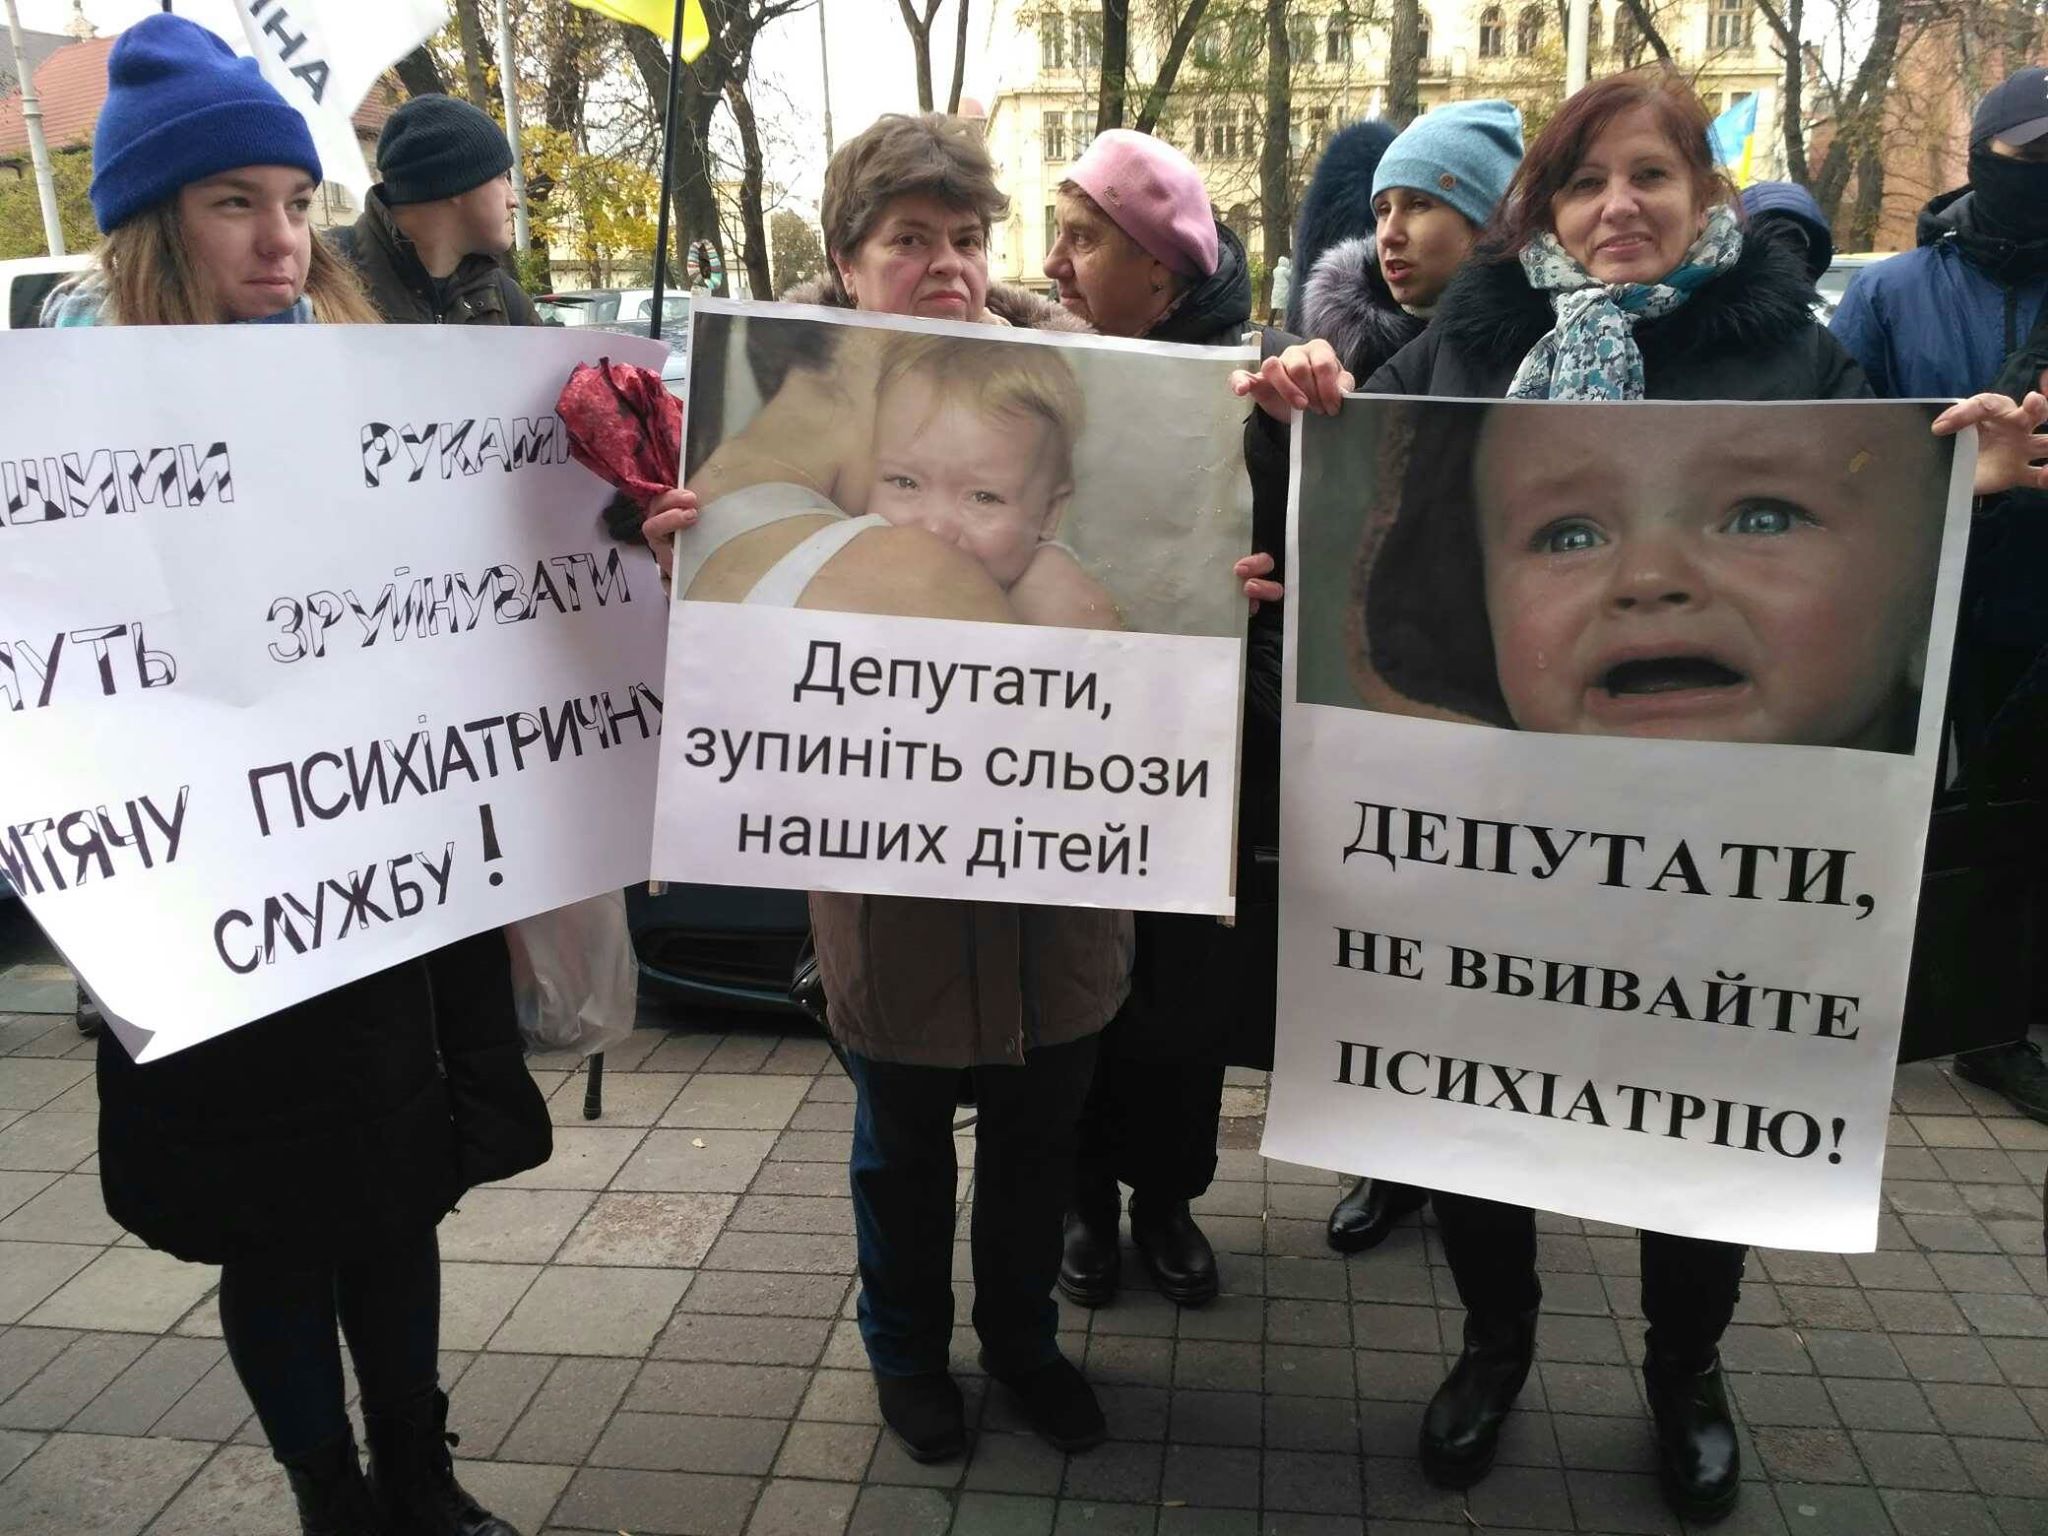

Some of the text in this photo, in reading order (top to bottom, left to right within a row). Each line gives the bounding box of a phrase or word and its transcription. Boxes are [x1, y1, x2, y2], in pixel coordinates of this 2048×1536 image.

[0, 442, 234, 527] ШИМИ
[266, 547, 632, 664] ЗРУЙНУВАТИ
[793, 640, 1112, 720] Депутати,
[684, 726, 1209, 798] зупиніть сльози
[737, 812, 1150, 879] наших дітей!
[1343, 801, 1876, 921] ДЕПУТАТИ,
[1332, 926, 1861, 1041] НЕ ВБИВАЙТЕ
[1332, 1040, 1846, 1165] ПСИХІАТРІЮ!
